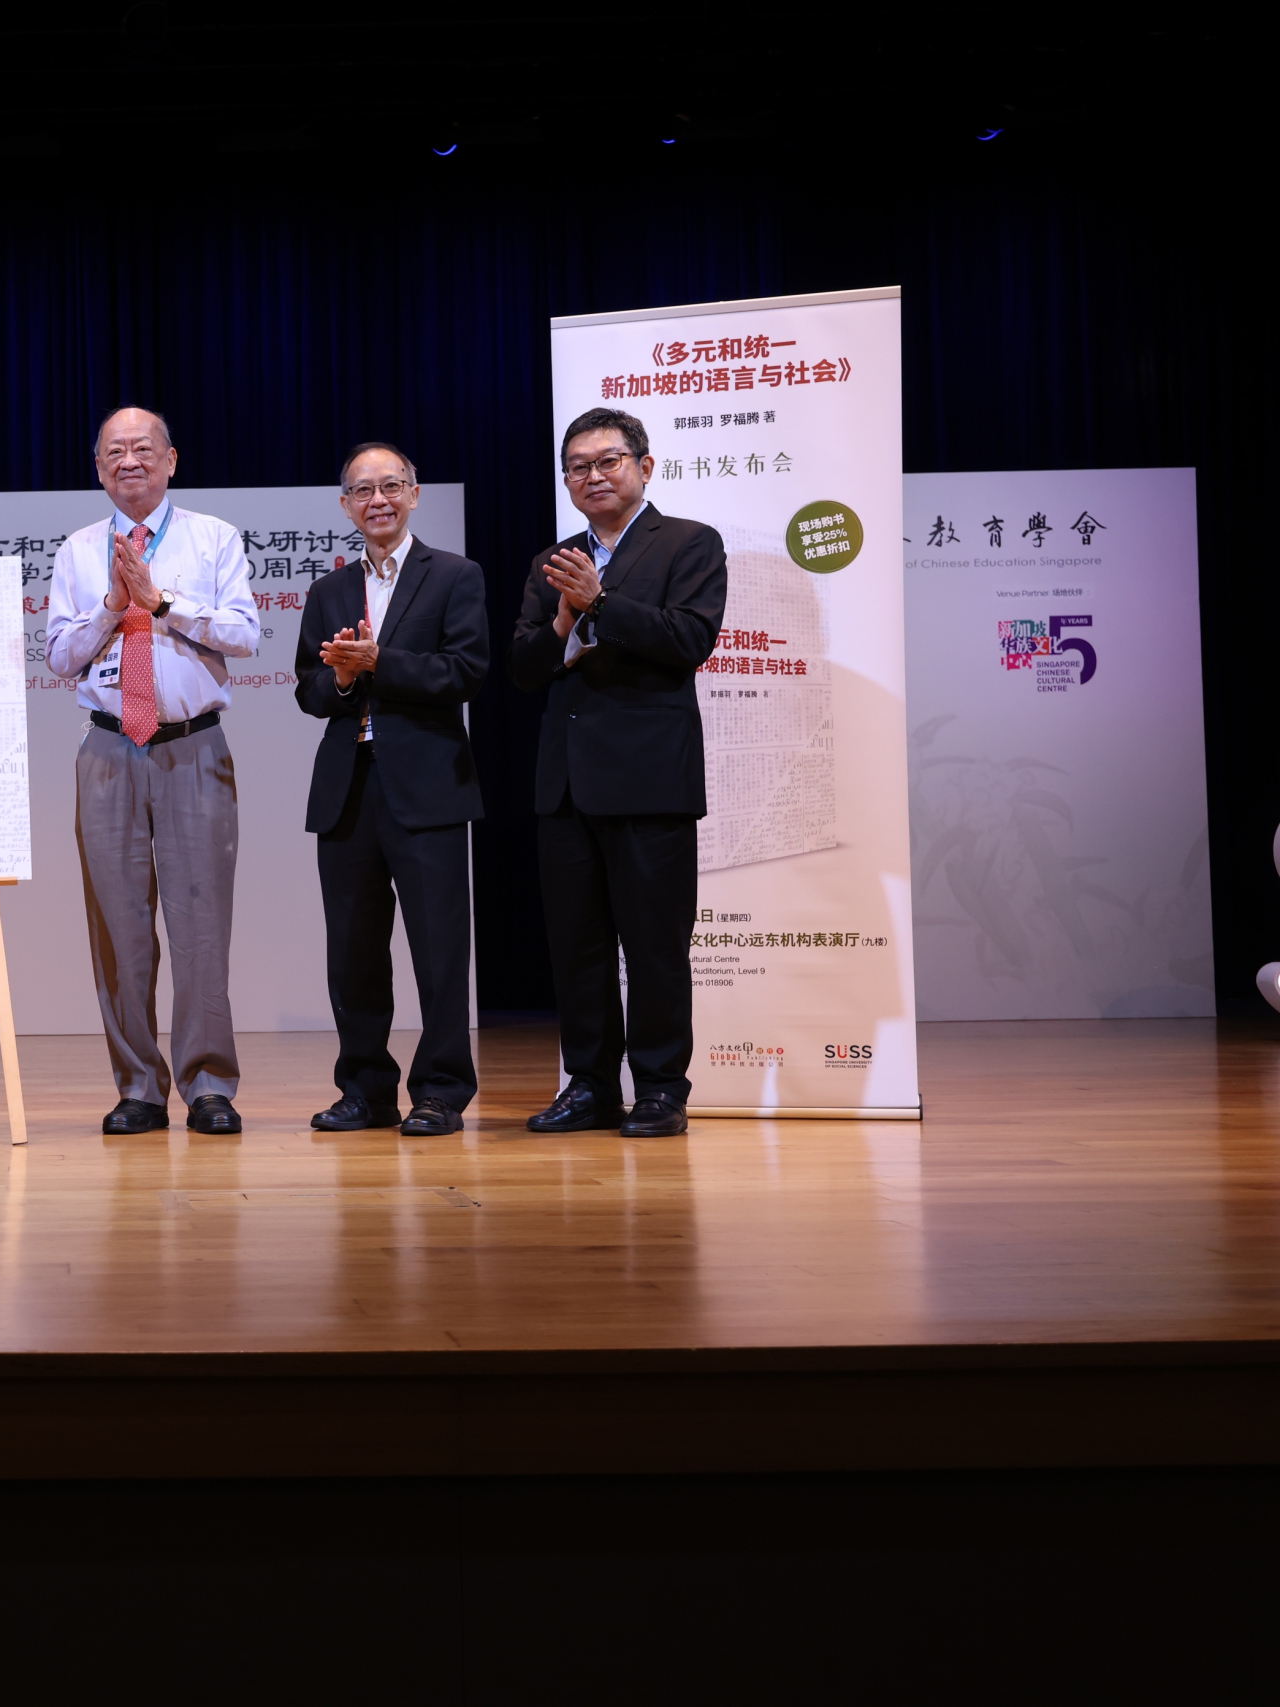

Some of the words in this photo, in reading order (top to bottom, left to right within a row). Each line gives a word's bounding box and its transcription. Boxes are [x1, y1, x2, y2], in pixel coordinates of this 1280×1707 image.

[651, 334, 797, 368] 《多元和统一
[601, 356, 852, 400] 新加坡的语言与社会》
[673, 414, 714, 430] 郭振羽
[720, 412, 760, 427] 罗福腾
[763, 410, 776, 423] 著
[661, 451, 793, 481] 新书发布会
[797, 513, 846, 534] 现场购书
[903, 511, 1107, 548] 教育學會
[801, 527, 848, 546] 享受25%
[803, 540, 851, 561] 优惠折扣
[920, 558, 970, 570] Chinese
[973, 557, 1036, 568] Education
[1039, 555, 1102, 570] Singapore
[996, 590, 1020, 598] Venue
[714, 955, 740, 964] Centre
[692, 967, 736, 976] Auditorium,
[738, 967, 758, 975] Level
[760, 967, 766, 975] 9
[705, 979, 734, 987] 018906
[710, 1053, 741, 1061] Global
[824, 1044, 873, 1059] SUSS
